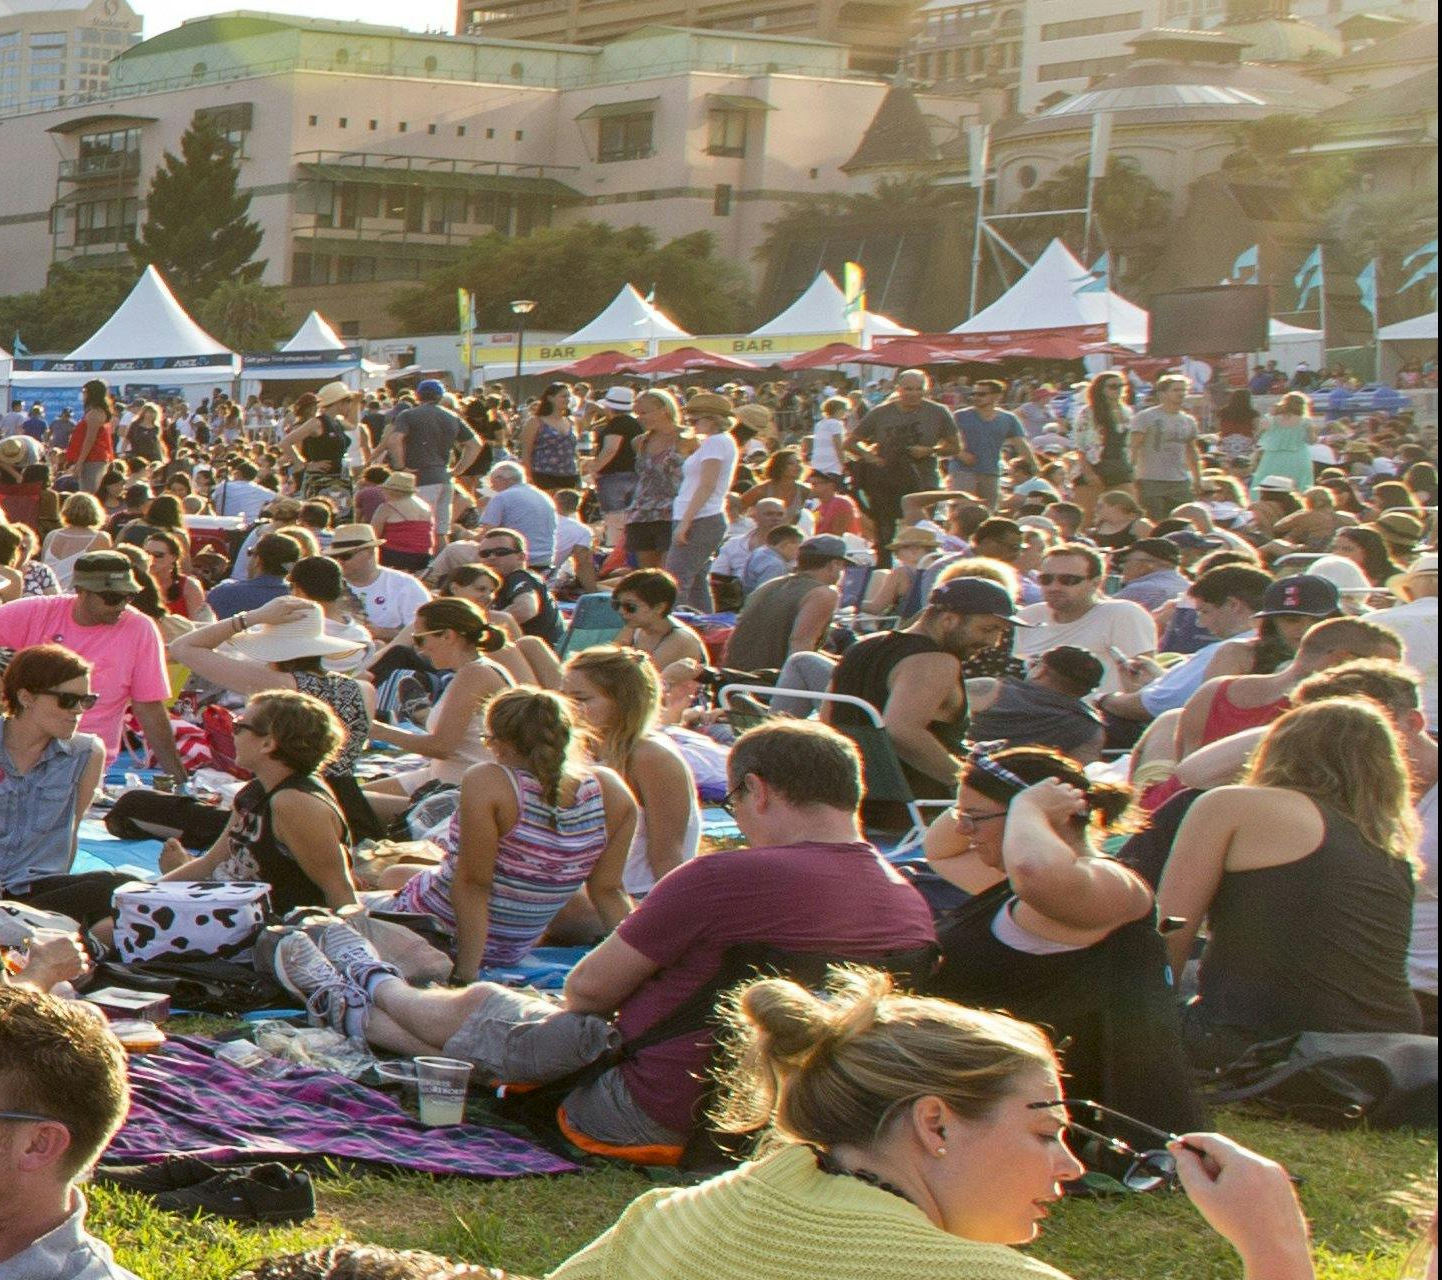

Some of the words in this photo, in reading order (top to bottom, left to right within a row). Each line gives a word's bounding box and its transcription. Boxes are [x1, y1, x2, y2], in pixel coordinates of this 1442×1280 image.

[733, 340, 772, 352] BAR
[540, 347, 575, 359] BAR
[51, 362, 75, 371] ANZ
[112, 361, 136, 370] ANZ
[174, 359, 197, 368] ANZ
